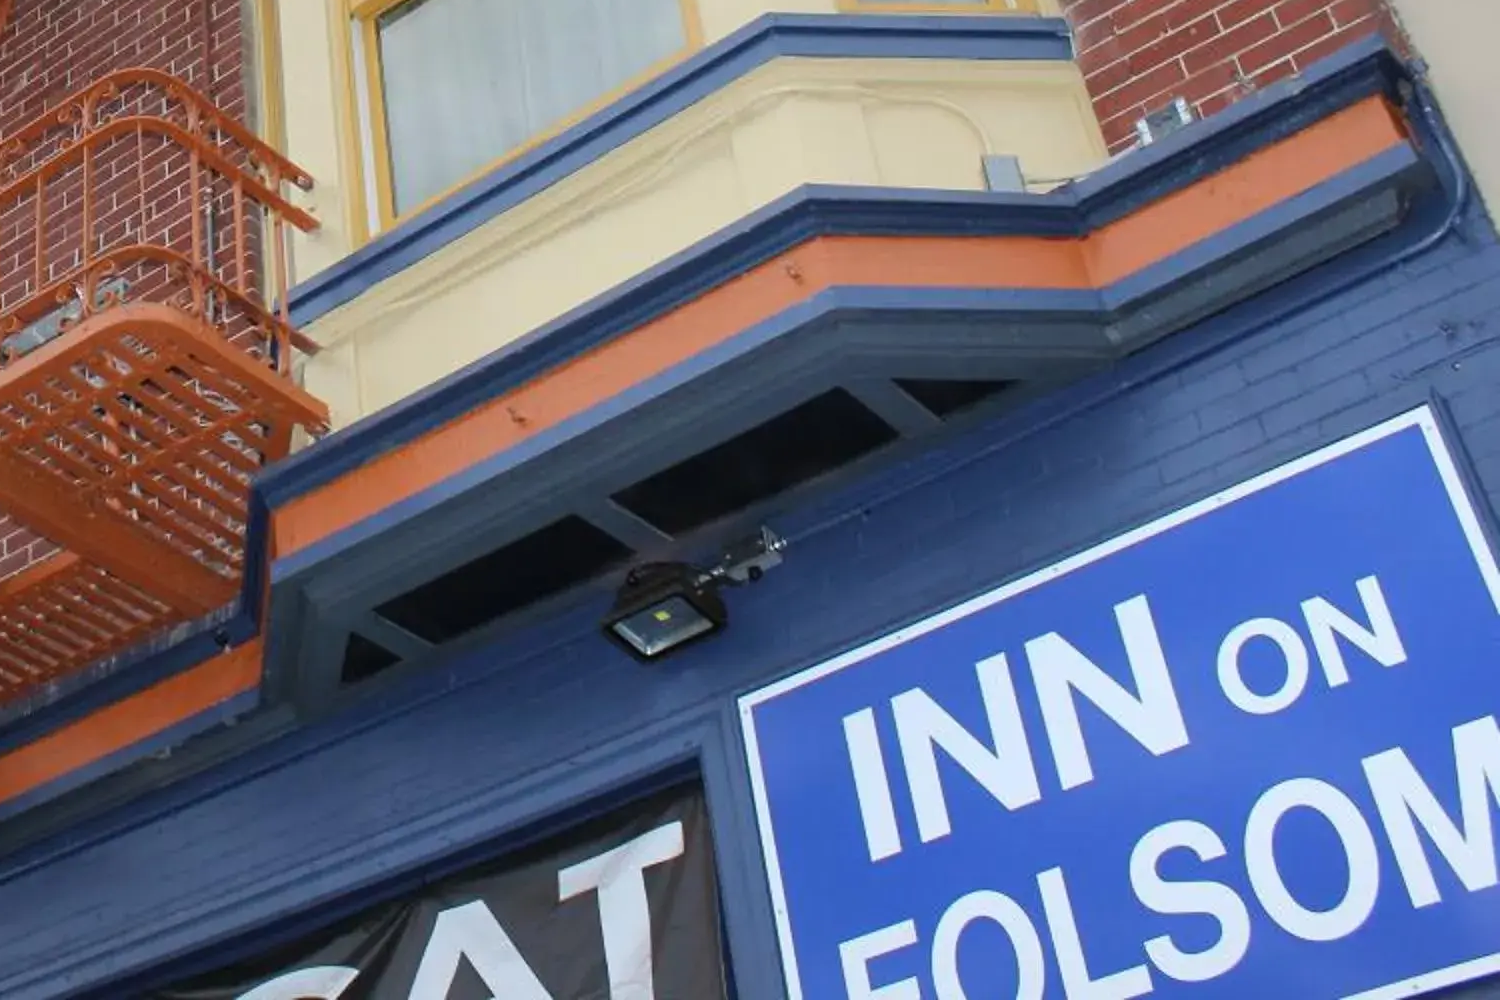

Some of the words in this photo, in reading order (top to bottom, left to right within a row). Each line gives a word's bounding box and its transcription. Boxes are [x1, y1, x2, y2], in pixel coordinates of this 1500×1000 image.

[842, 594, 1190, 862] INN
[1216, 575, 1407, 715] ON
[233, 820, 686, 1000] AT
